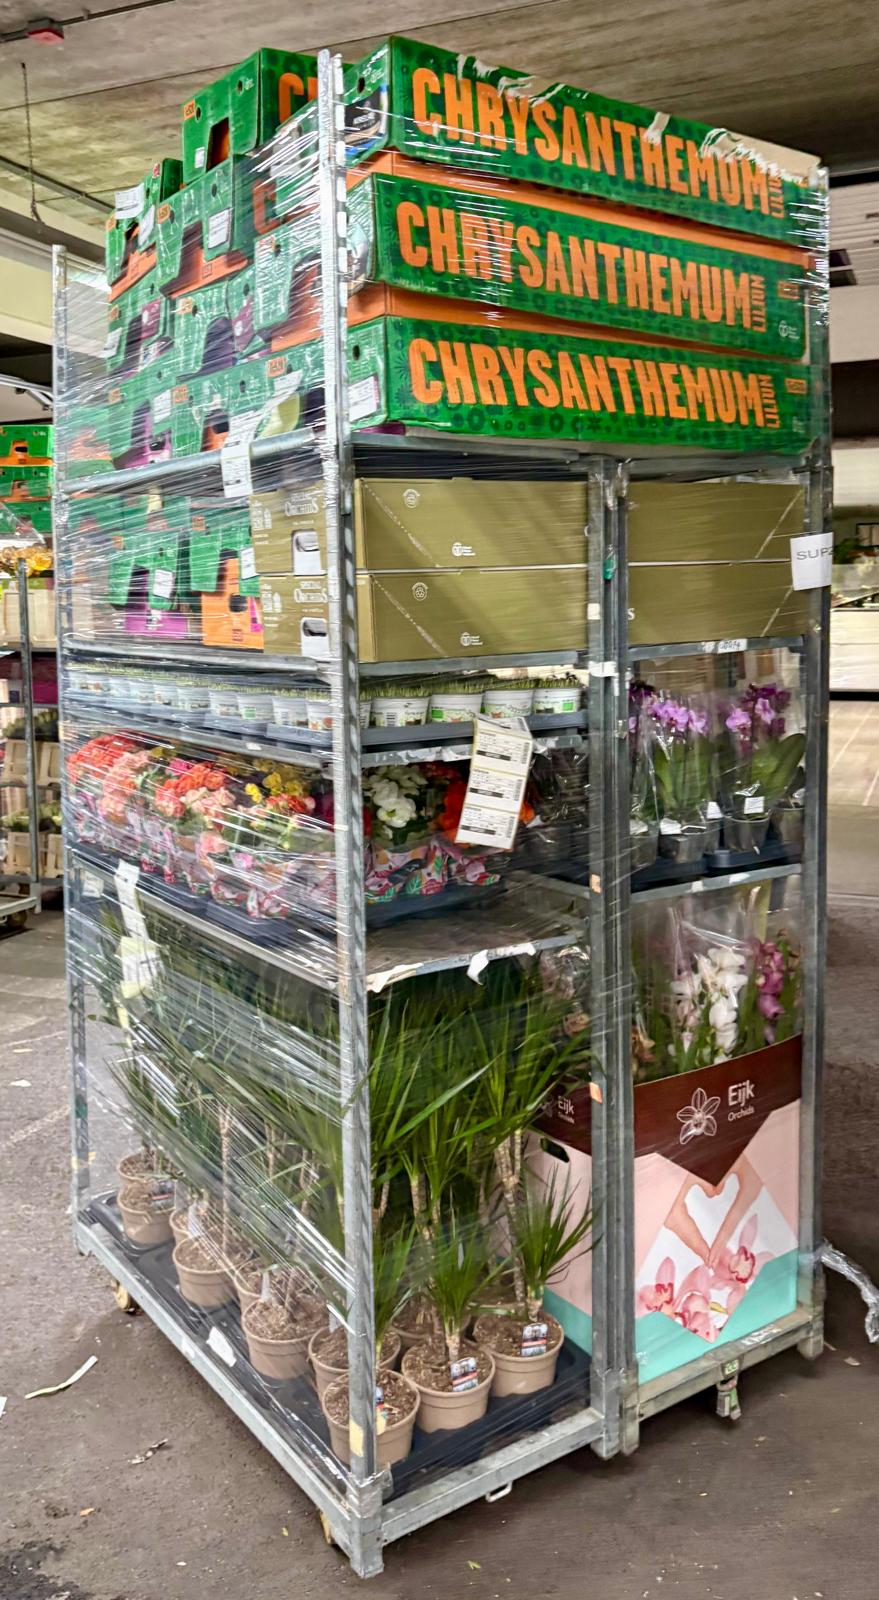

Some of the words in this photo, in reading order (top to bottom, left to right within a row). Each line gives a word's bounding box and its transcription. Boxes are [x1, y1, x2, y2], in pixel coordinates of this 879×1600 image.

[412, 67, 770, 215] CHRYSANTHEMUM
[396, 201, 752, 330] CHRYSANTHEMUM
[749, 274, 767, 333] LILIUM
[408, 338, 765, 427] CHRYSANTHEMUM
[758, 374, 781, 429] LILIUM
[727, 1105, 755, 1121] Orchids
[728, 1079, 755, 1107] Eijk
